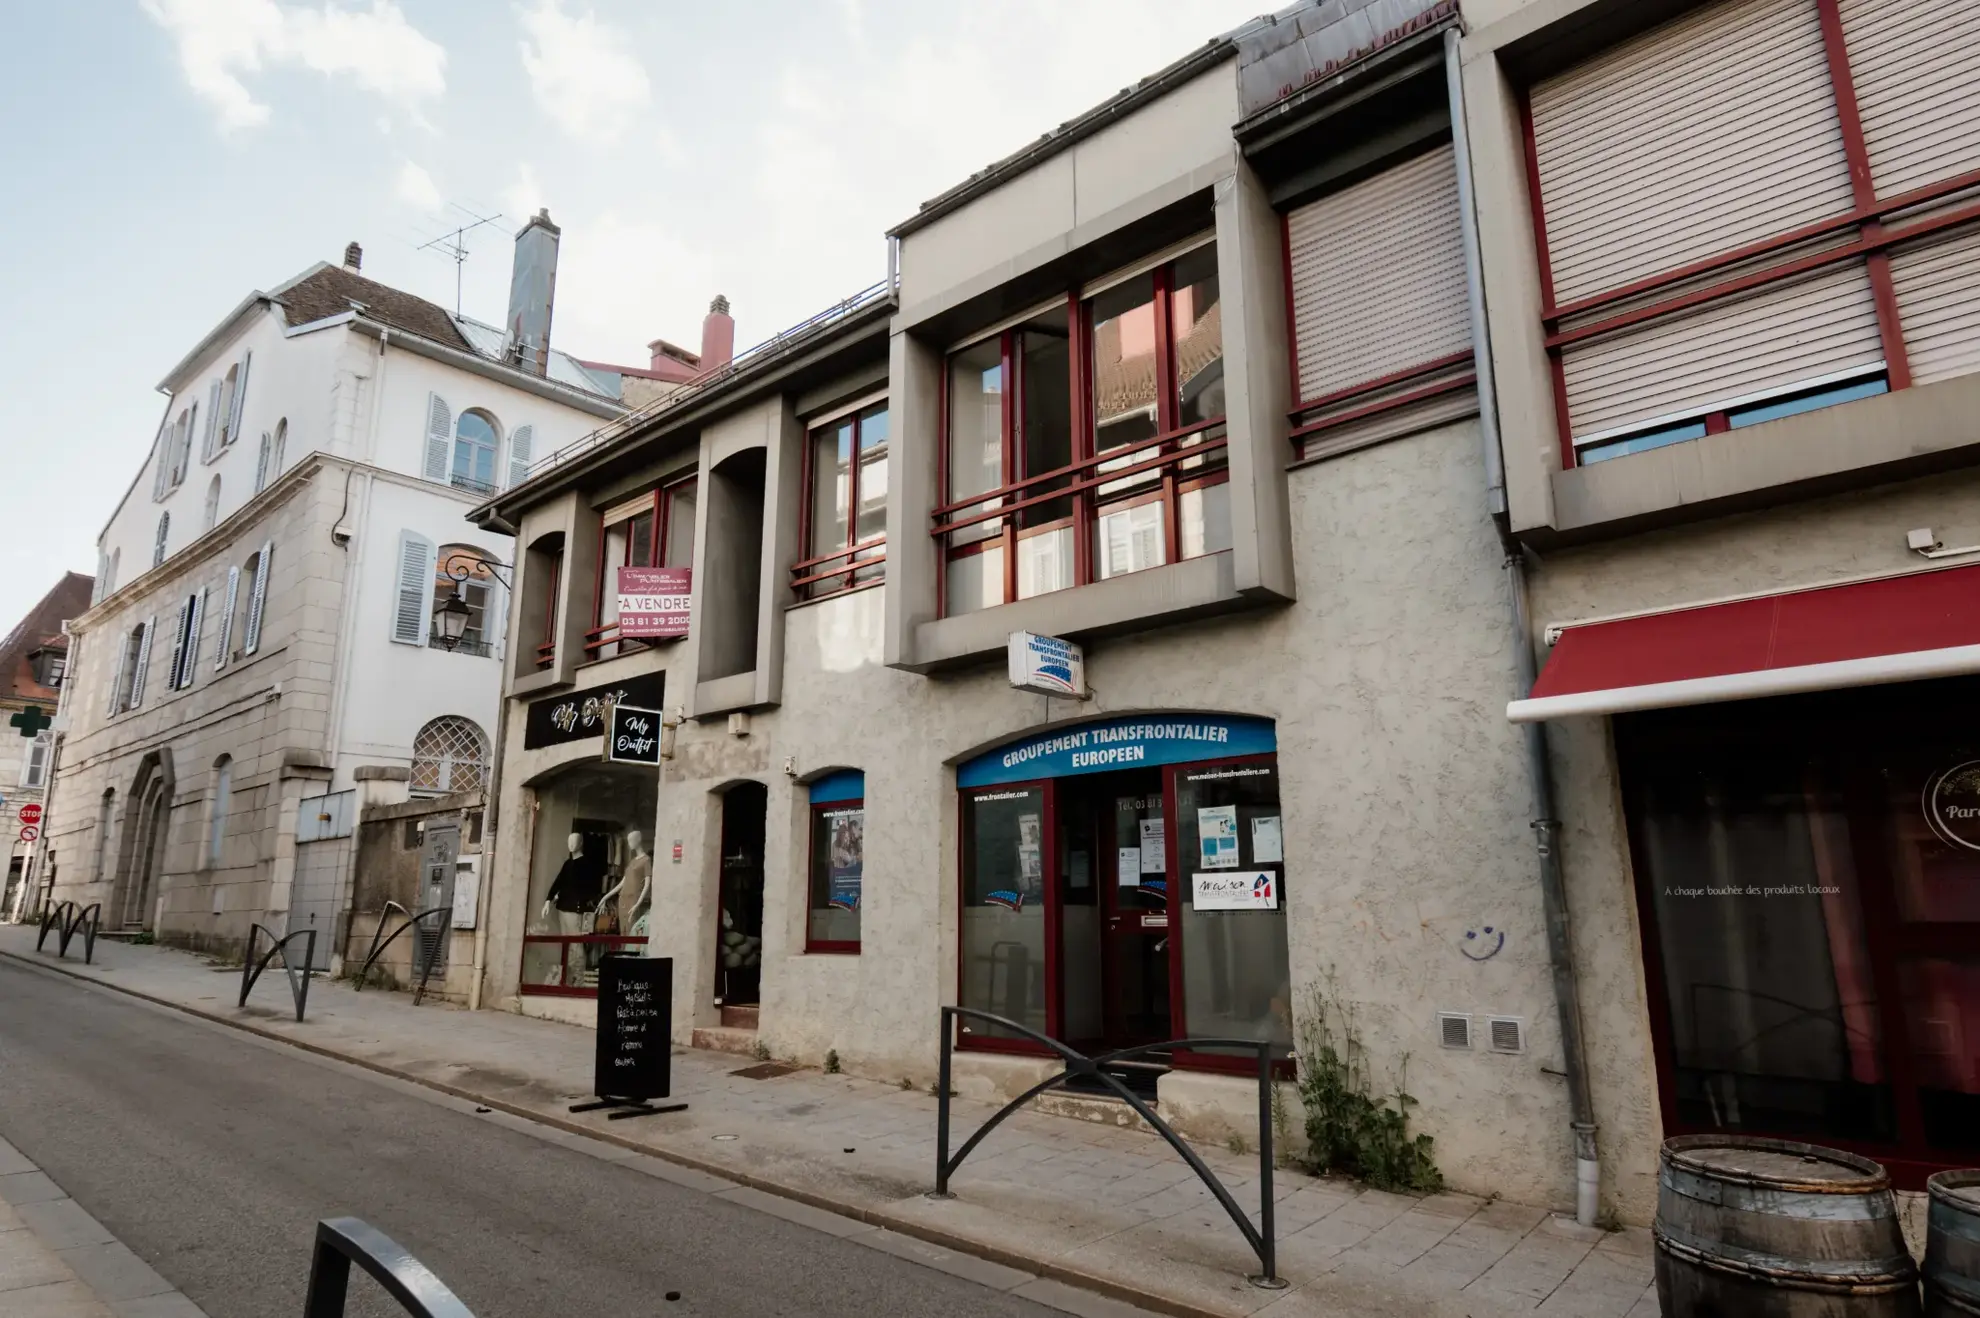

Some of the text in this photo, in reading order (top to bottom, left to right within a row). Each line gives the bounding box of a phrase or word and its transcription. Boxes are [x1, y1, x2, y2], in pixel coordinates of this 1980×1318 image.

[635, 597, 690, 610] VENDRE
[622, 617, 635, 626] 03
[637, 617, 649, 625] 81
[652, 617, 665, 625] 39
[1034, 635, 1072, 652] GROUPEMENT
[1028, 642, 1080, 663] TRANSFRONTALIER
[1041, 655, 1069, 667] EUROPEEN
[625, 716, 650, 735] My
[617, 735, 657, 755] Outfit
[1002, 724, 1229, 768] GROUPEMENT TRANSFRONTALIER
[1071, 745, 1145, 767] EUROPEEN
[974, 791, 1029, 802] www.frontalier.com
[1135, 799, 1146, 810] 03
[1674, 885, 1705, 898] chaque
[1746, 885, 1761, 895] des
[1764, 884, 1805, 898] produits
